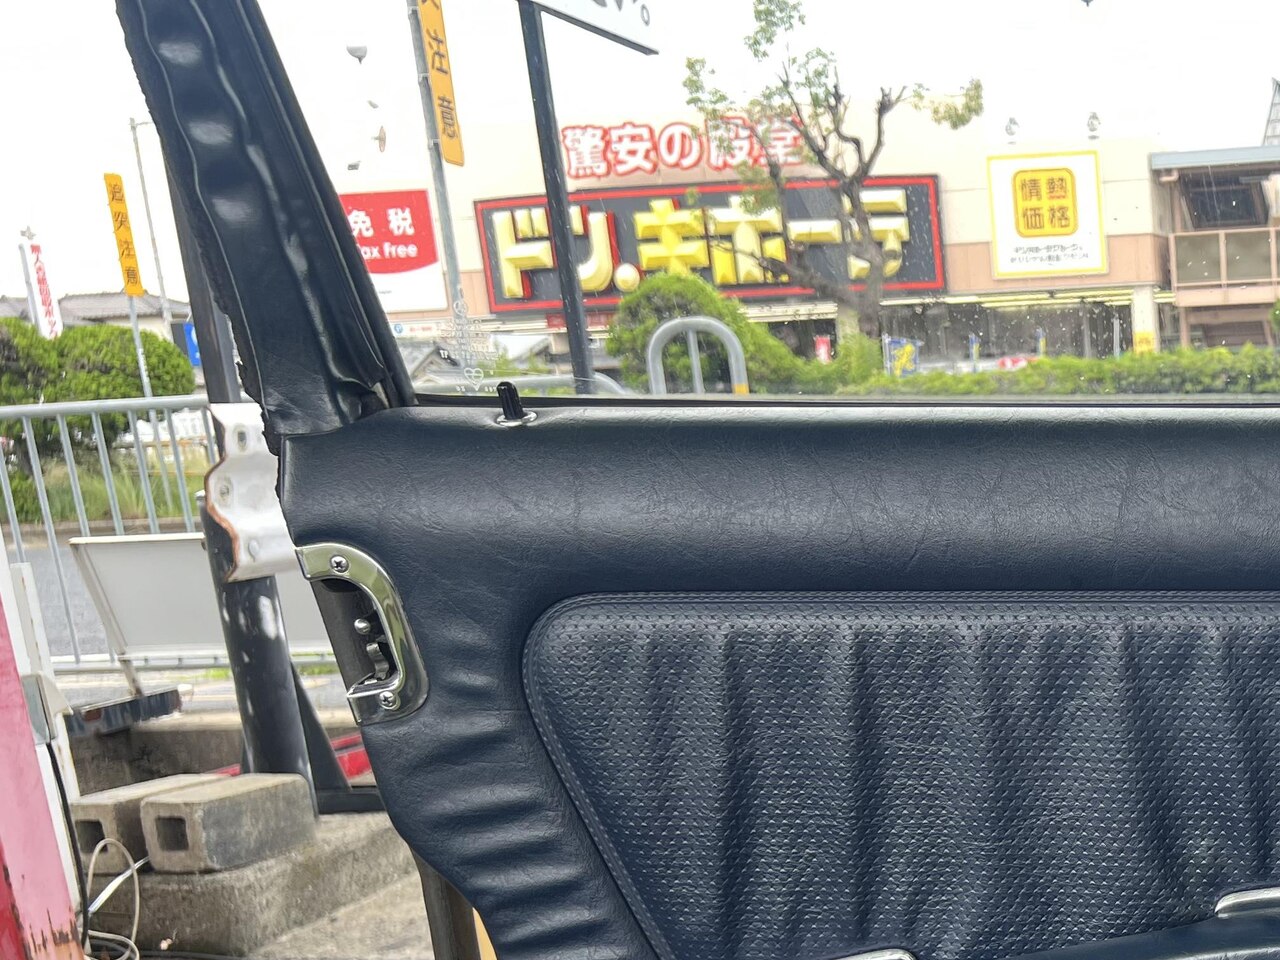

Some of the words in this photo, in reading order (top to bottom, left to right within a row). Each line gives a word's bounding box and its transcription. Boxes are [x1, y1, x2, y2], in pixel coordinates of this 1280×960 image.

[422, 0, 458, 140] 注意
[357, 245, 381, 259] ax
[383, 241, 418, 258] free
